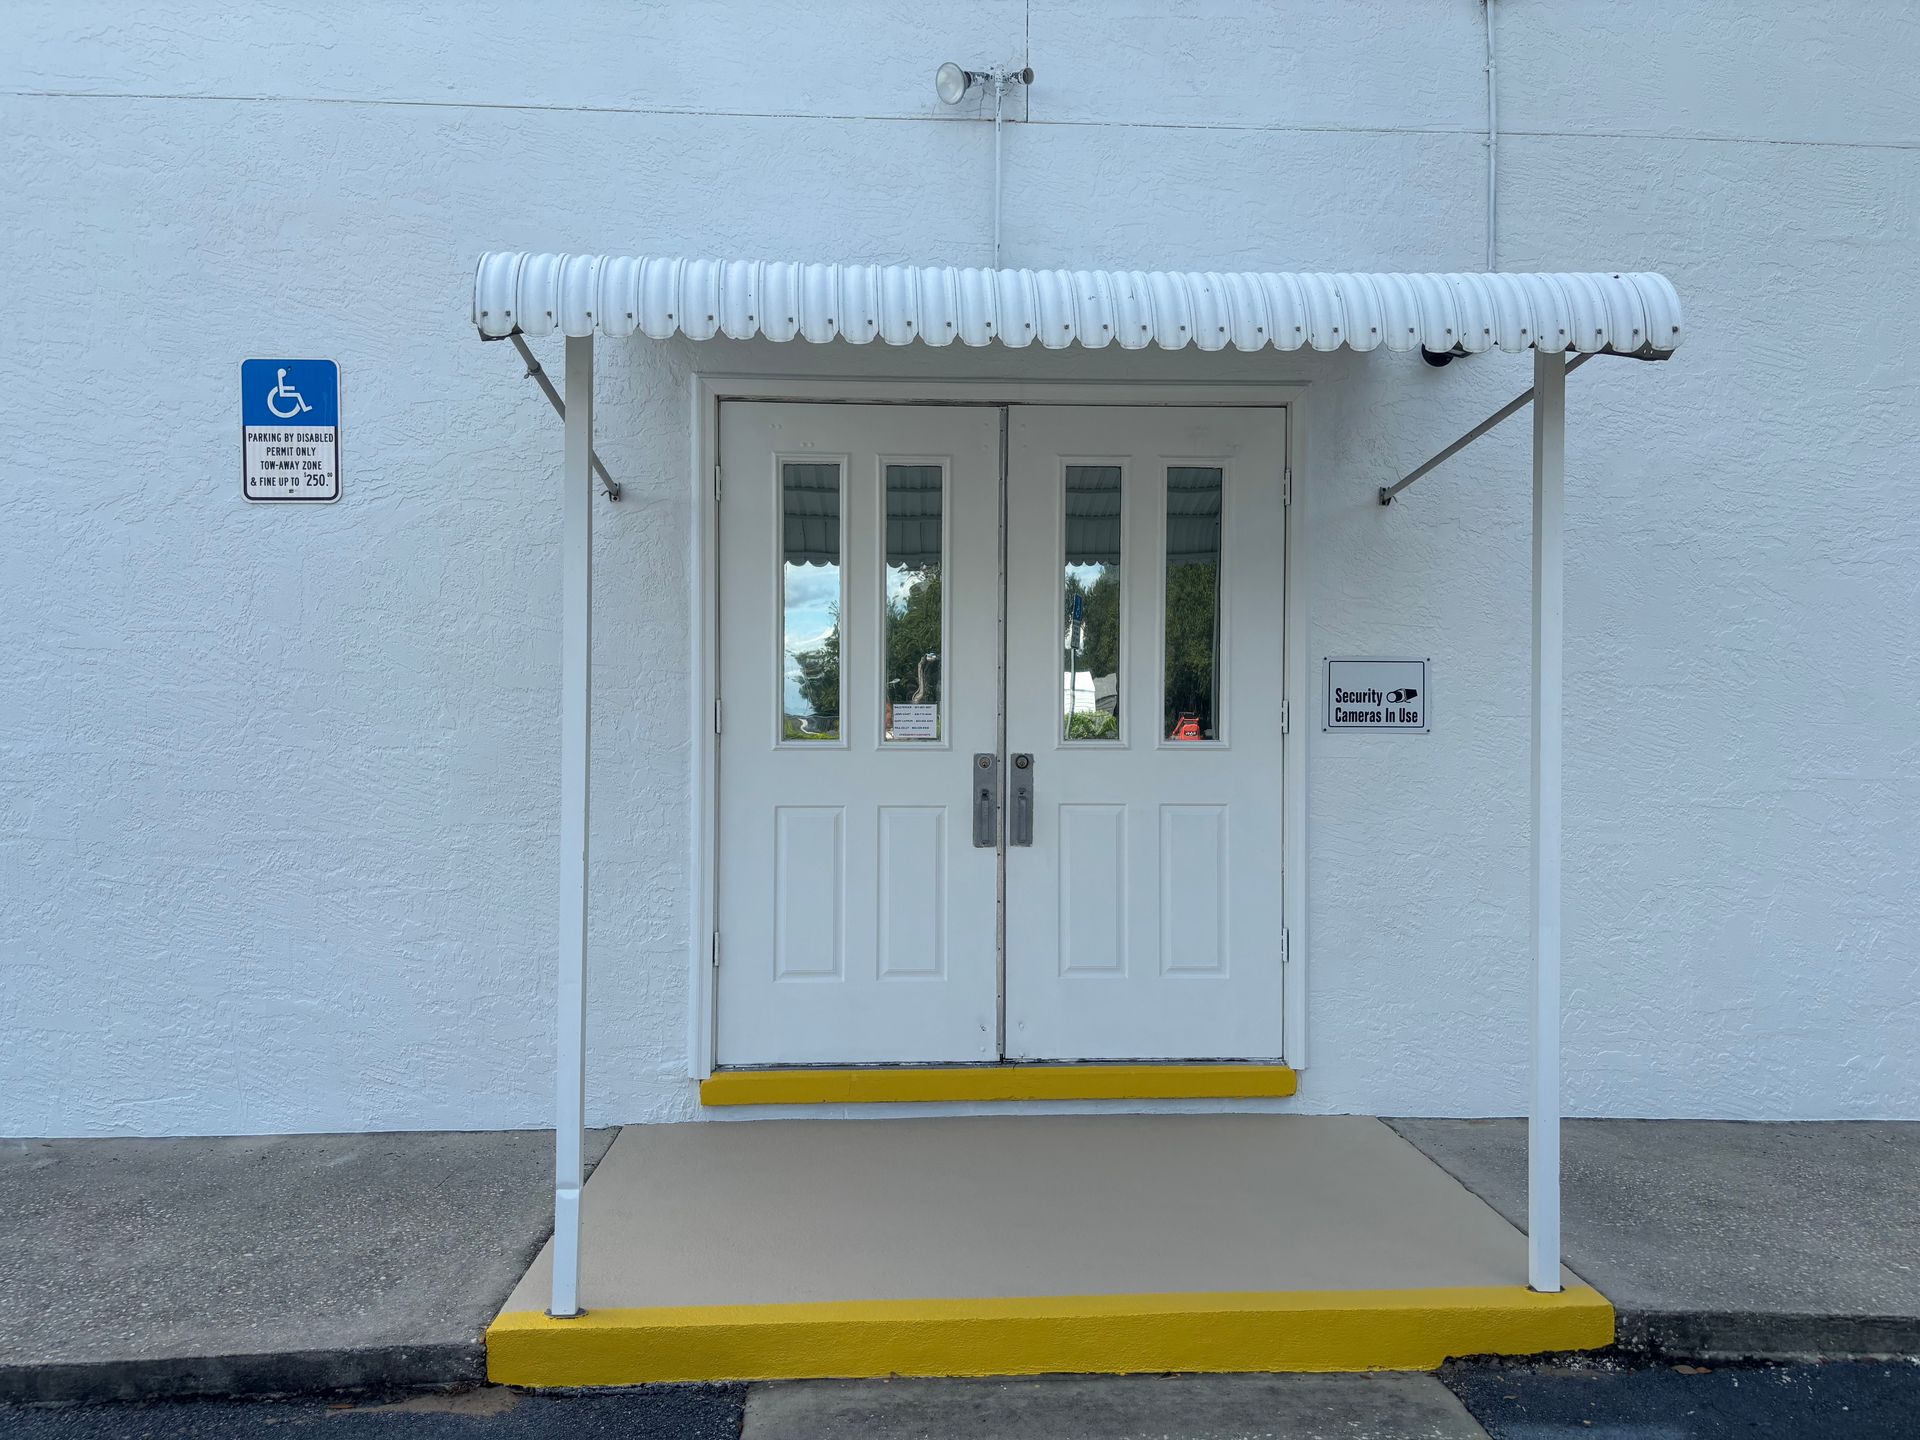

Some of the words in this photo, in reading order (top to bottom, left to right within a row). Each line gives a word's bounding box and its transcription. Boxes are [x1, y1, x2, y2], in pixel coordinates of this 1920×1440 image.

[248, 433, 281, 442] PARKING
[284, 433, 294, 442] BY
[297, 433, 334, 443] DISABLED
[266, 447, 293, 456] PERMIT
[296, 447, 316, 456] ONLY
[260, 460, 299, 470] TOW-AWAY
[302, 460, 322, 470] ZONE
[250, 477, 257, 486] &
[259, 477, 276, 486] FINE
[279, 477, 289, 486] UP
[290, 477, 300, 486] TO
[1335, 687, 1383, 707] Security
[1335, 707, 1382, 723] Cameras
[1385, 707, 1396, 723] In
[1399, 707, 1418, 723] Use
